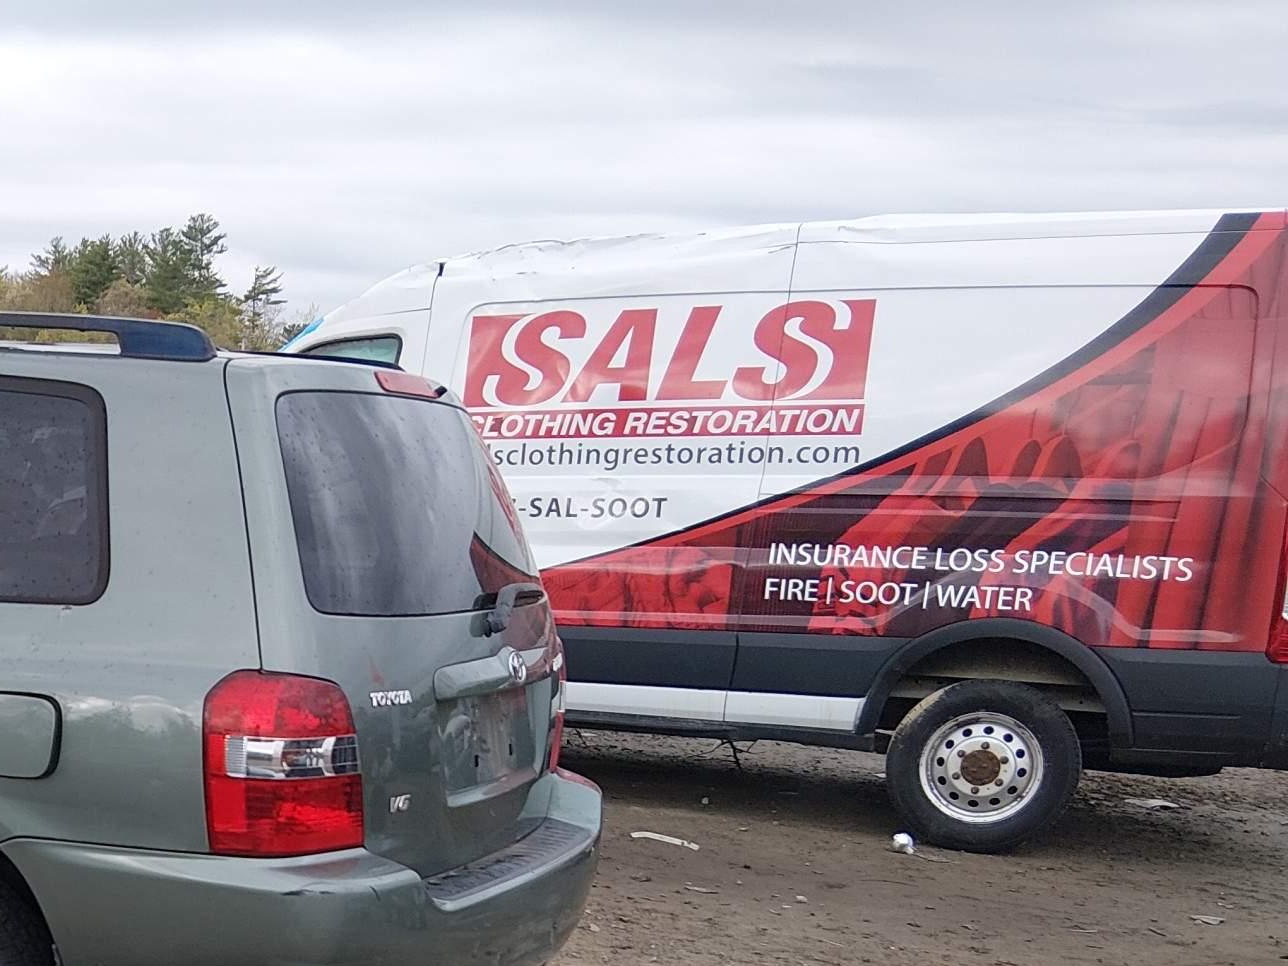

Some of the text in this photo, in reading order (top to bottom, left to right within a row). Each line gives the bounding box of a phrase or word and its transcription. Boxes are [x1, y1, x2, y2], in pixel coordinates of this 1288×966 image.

[480, 299, 852, 407] SALS
[627, 408, 859, 436] RESTORATION
[512, 498, 668, 518] -SAL-SOOT
[768, 543, 1194, 582] INSURANCE LOSS SPECIALISTS
[763, 578, 819, 602] FIRE
[839, 580, 918, 606] SOOT
[936, 584, 1033, 612] WATER
[370, 690, 412, 707] TOYOTA
[390, 794, 411, 813] V6
